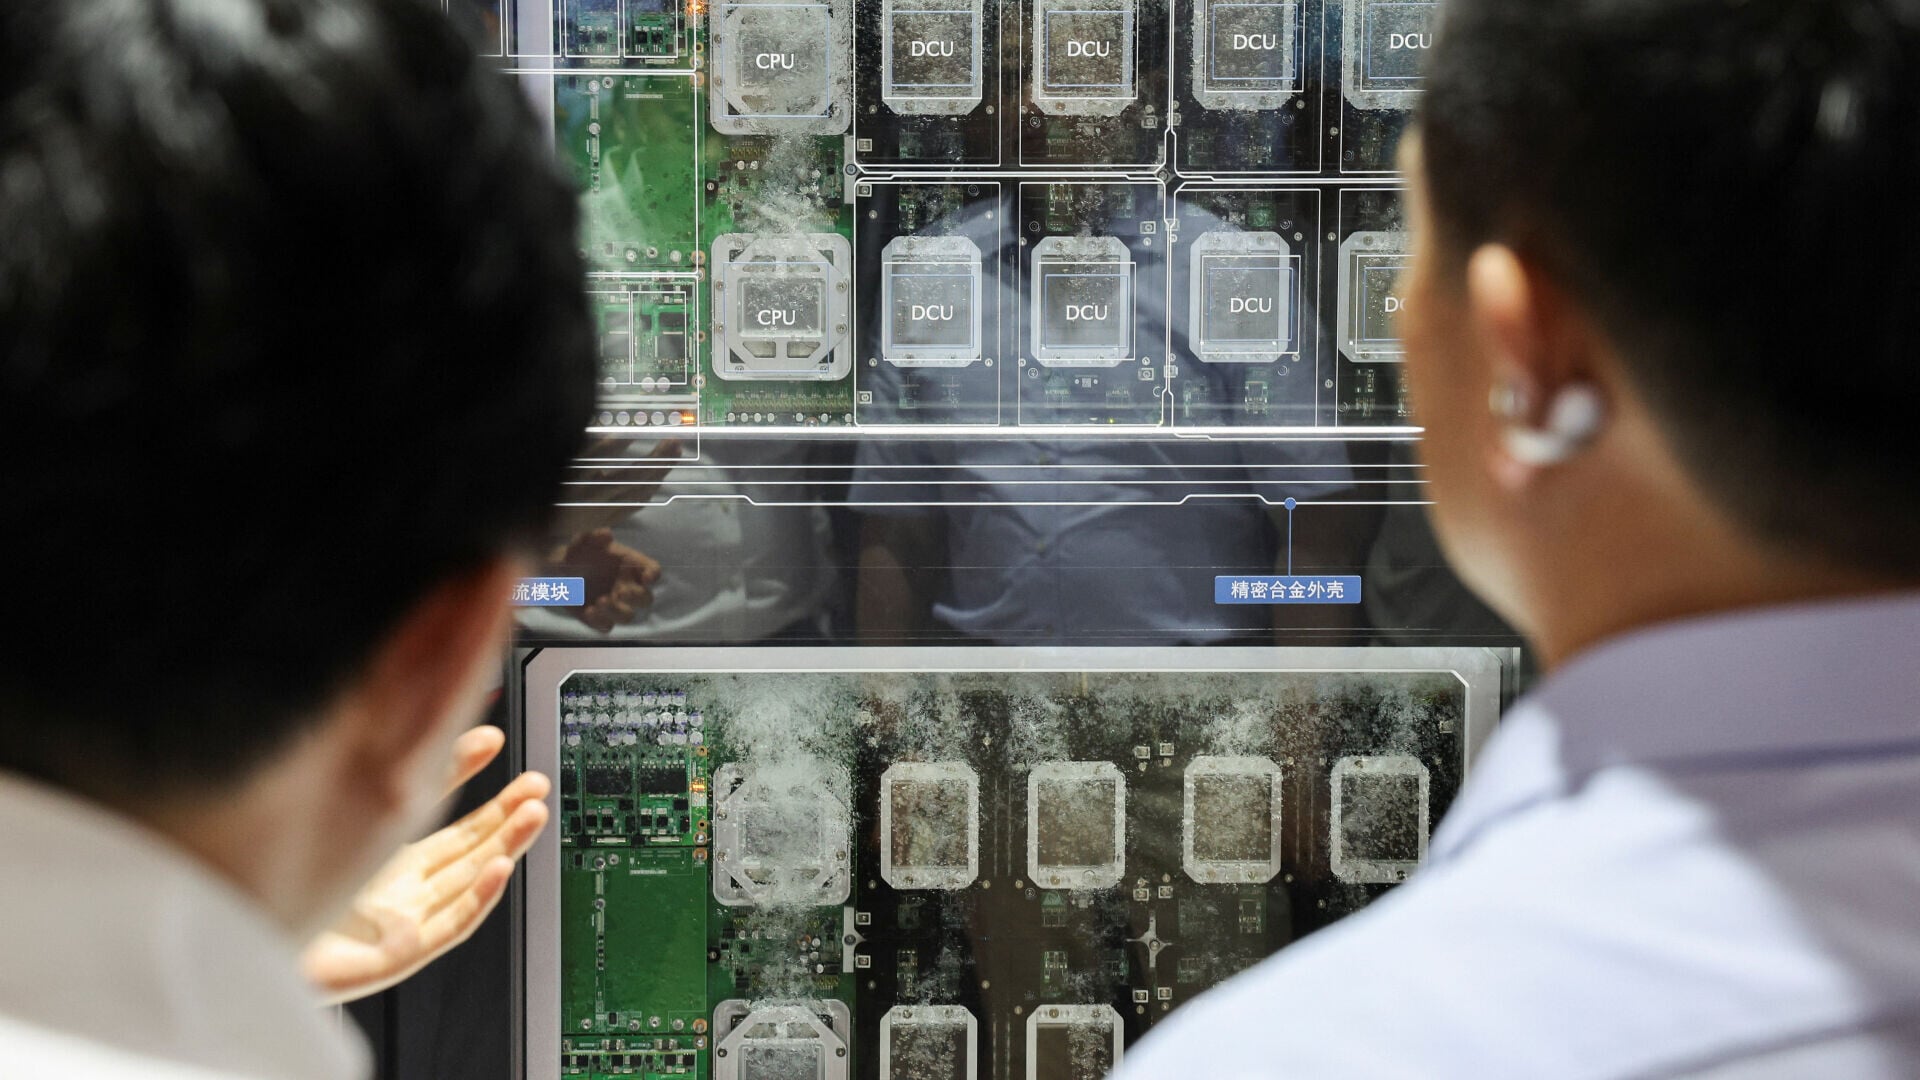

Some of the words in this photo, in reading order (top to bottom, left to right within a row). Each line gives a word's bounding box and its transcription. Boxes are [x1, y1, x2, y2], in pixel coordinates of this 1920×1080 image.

[911, 40, 954, 57] DCU
[1067, 41, 1110, 57] DCU
[1233, 34, 1276, 50] DCU
[1390, 33, 1433, 49] DCU
[756, 53, 795, 70] CPU
[911, 305, 954, 321] DCU
[1066, 305, 1108, 321] DCU
[1230, 297, 1272, 314] DCU
[757, 310, 796, 325] CPU
[509, 582, 570, 601] 流模块
[1231, 580, 1344, 601] 精密合金外壳
